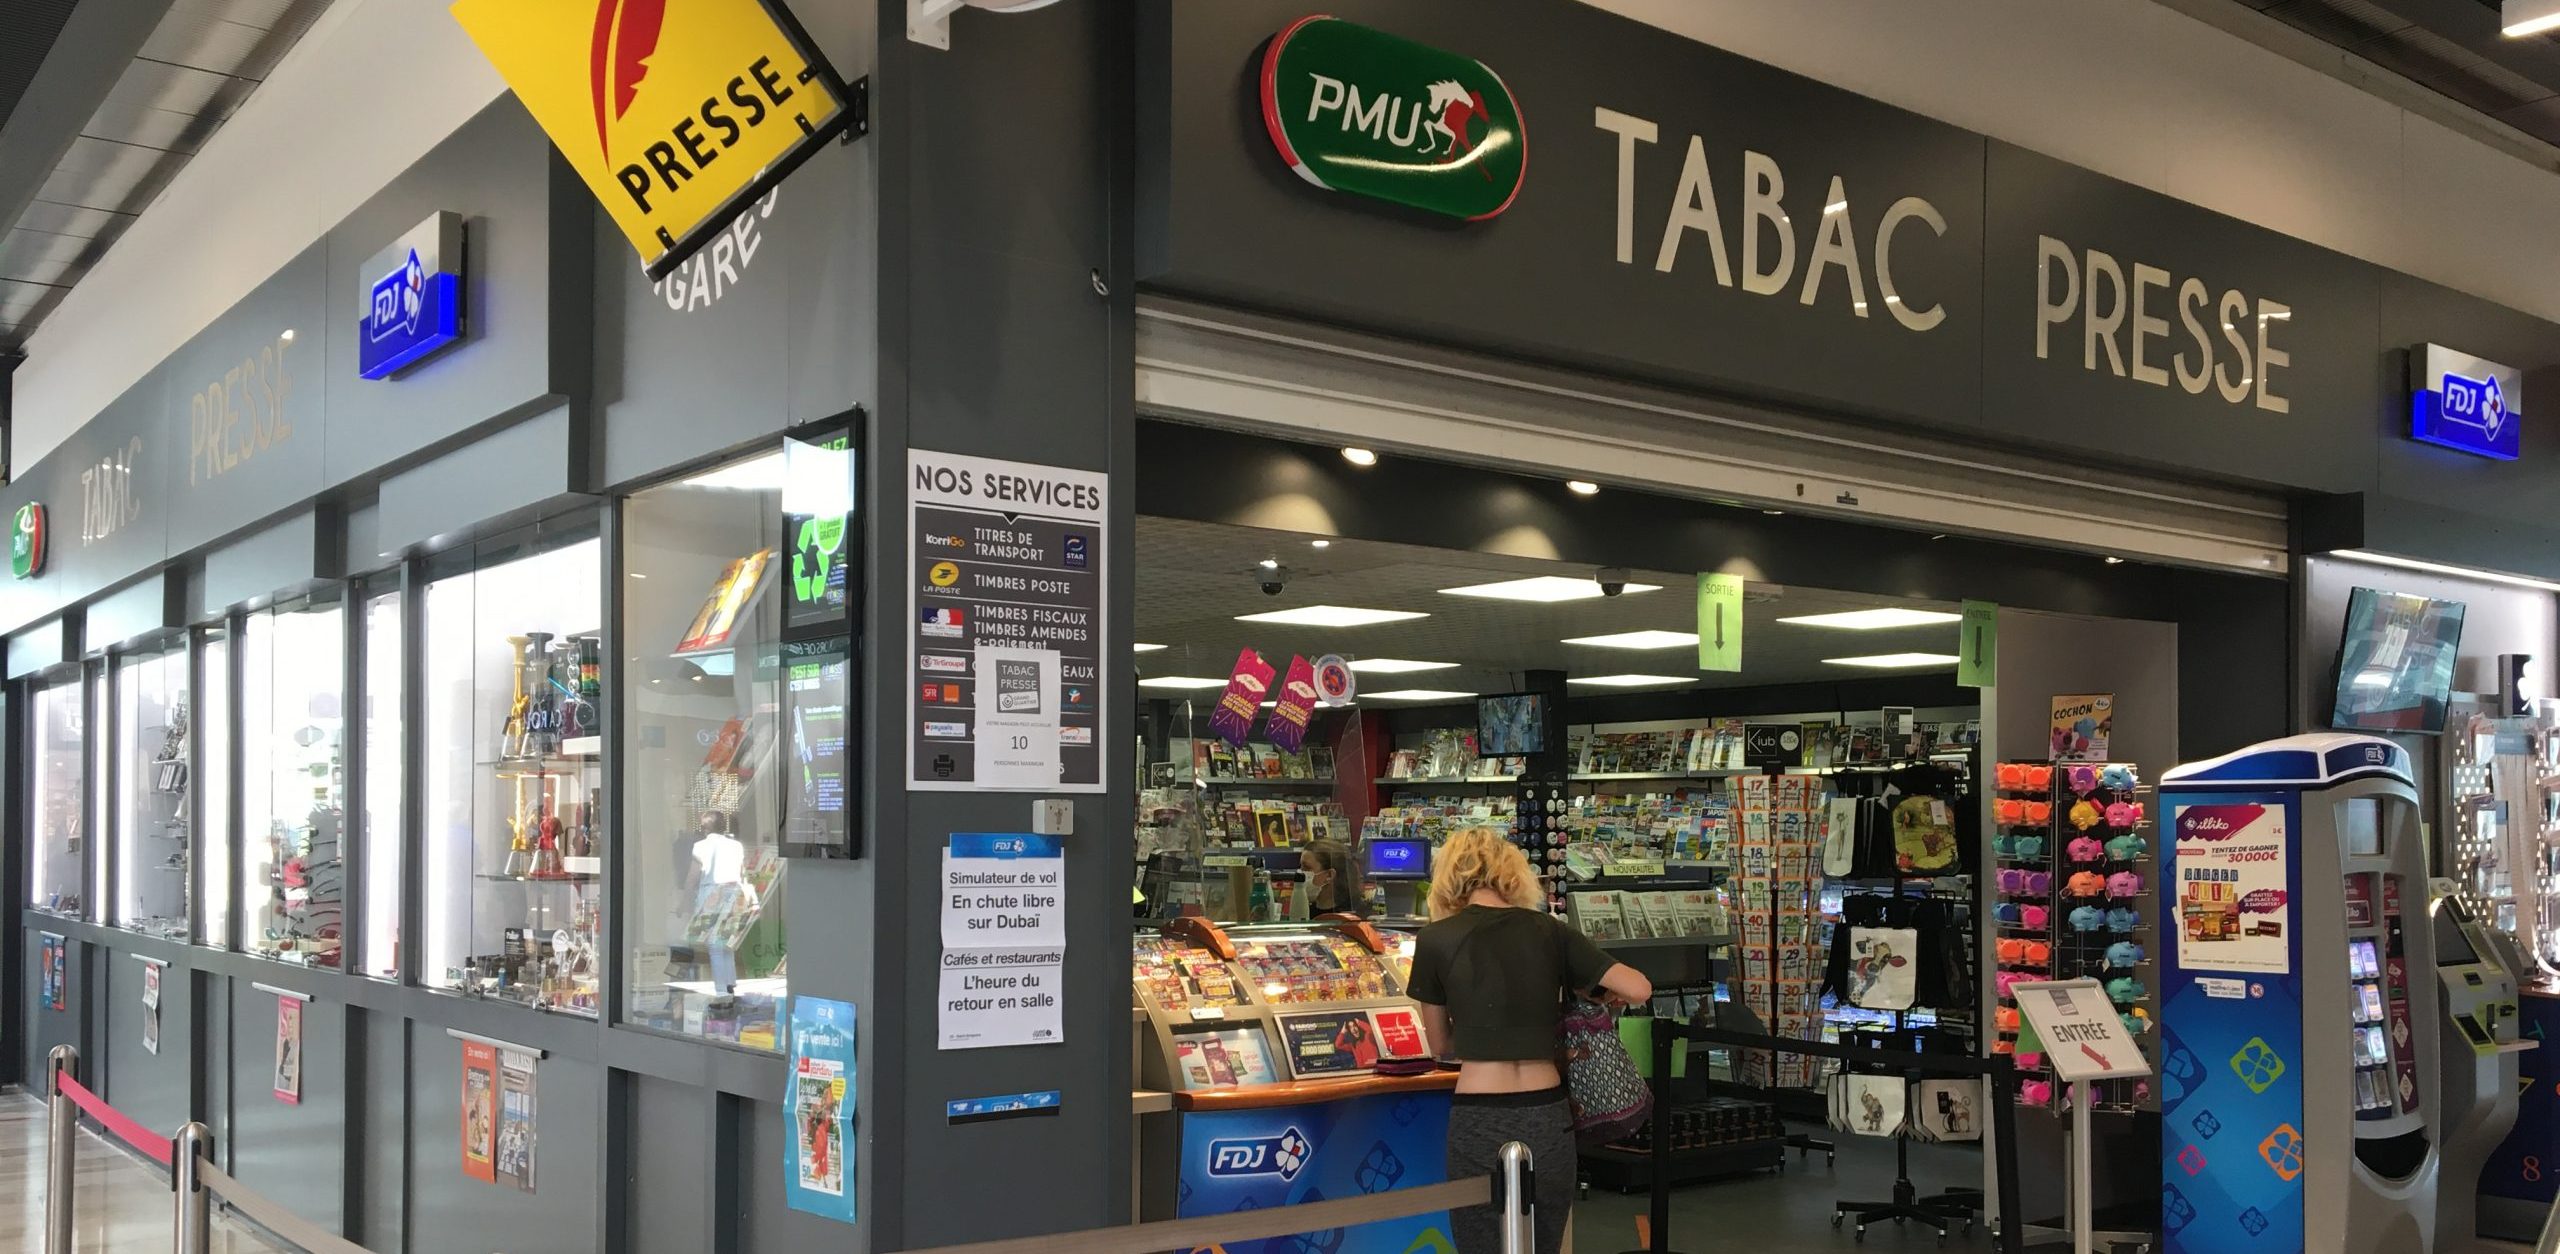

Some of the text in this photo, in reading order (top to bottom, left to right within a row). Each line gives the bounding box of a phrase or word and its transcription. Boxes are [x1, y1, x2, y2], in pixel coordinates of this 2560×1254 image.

[1307, 72, 1423, 147] PMU
[616, 55, 794, 214] PRESSE
[1595, 106, 2291, 413] TABAC PRESSE
[374, 282, 400, 330] FDJ
[2446, 383, 2476, 416] FDJ
[190, 329, 294, 487] PRESSE
[81, 435, 142, 547] TABAC
[916, 464, 1100, 510] NOS SERVICES
[974, 527, 1033, 545] TITRES DE
[974, 543, 1044, 561] TRANSPORT
[1066, 552, 1084, 560] STAR
[923, 585, 961, 595] LA POSTE
[974, 574, 1070, 594] TIMBRES POSTE
[1706, 583, 1734, 596] SORTIE
[974, 605, 1087, 625] TIMBRES FISCAUX
[974, 621, 1026, 637] TIMBRES
[1031, 625, 1087, 641] AMENDES
[1001, 665, 1034, 676] TABAC
[1000, 679, 1037, 690] PRESSE
[924, 688, 937, 698] SFR
[2054, 703, 2093, 720] COCHON
[1011, 736, 1028, 750] 10
[1748, 728, 1776, 754] Kiub
[1750, 780, 1764, 791] 17
[1785, 780, 1799, 790] 24
[1707, 808, 1727, 816] JAPON
[1750, 813, 1762, 825] 18
[1785, 813, 1798, 825] 25
[2196, 817, 2229, 830] illiko
[994, 841, 1011, 850] FDJ
[2211, 846, 2237, 854] TENTEZ
[1750, 847, 1762, 859] 18
[2228, 853, 2243, 863] 30
[950, 872, 1057, 884] Simulateur de vol
[2184, 868, 2239, 881] BURGER
[1752, 882, 1764, 891] 19
[2188, 882, 2234, 901] QUIZ
[952, 894, 1055, 909] En chute libre
[968, 913, 1040, 929] sur Dubaï
[1748, 915, 1763, 926] 40
[943, 951, 1061, 966] Cafés et restaurants
[1750, 949, 1764, 960] 20
[1786, 949, 1799, 960] 29
[964, 973, 1040, 990] L'heure du
[1750, 984, 1762, 995] 21
[1784, 985, 1800, 997] 30
[948, 993, 1053, 1011] retour en salle
[1787, 1020, 1800, 1032] 31
[2051, 1018, 2111, 1043] ENTRÉE
[1784, 1053, 1799, 1063] 32
[1215, 1145, 1267, 1169] FDJ
[2522, 1155, 2541, 1182] 8
